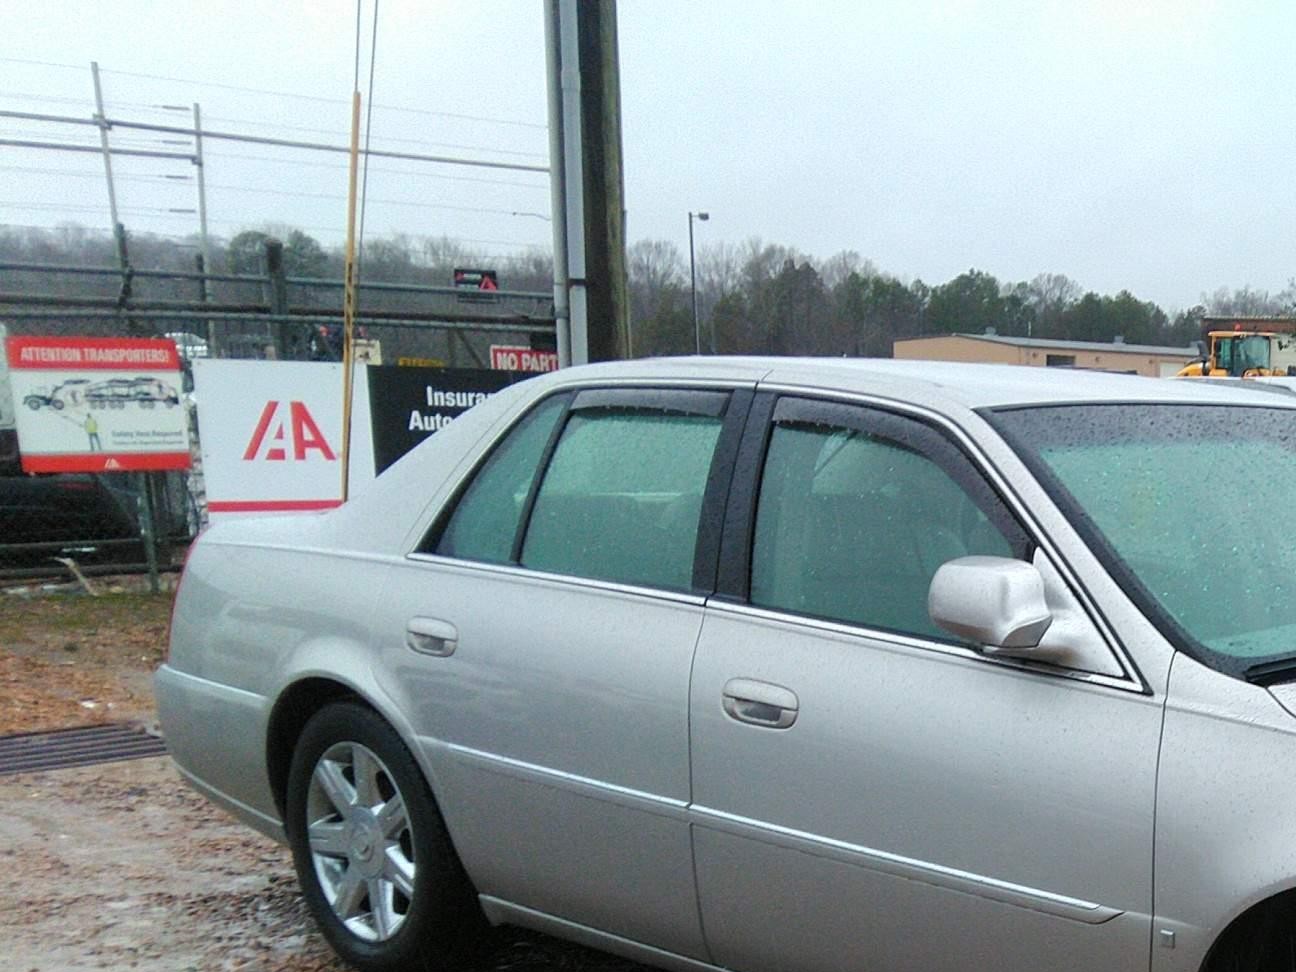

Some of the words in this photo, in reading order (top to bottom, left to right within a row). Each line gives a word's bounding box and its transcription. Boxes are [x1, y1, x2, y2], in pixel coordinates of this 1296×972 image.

[21, 347, 81, 361] ATTENTION
[83, 348, 168, 363] TRANSPORTERS!
[497, 352, 517, 370] NO
[426, 386, 497, 406] Insura
